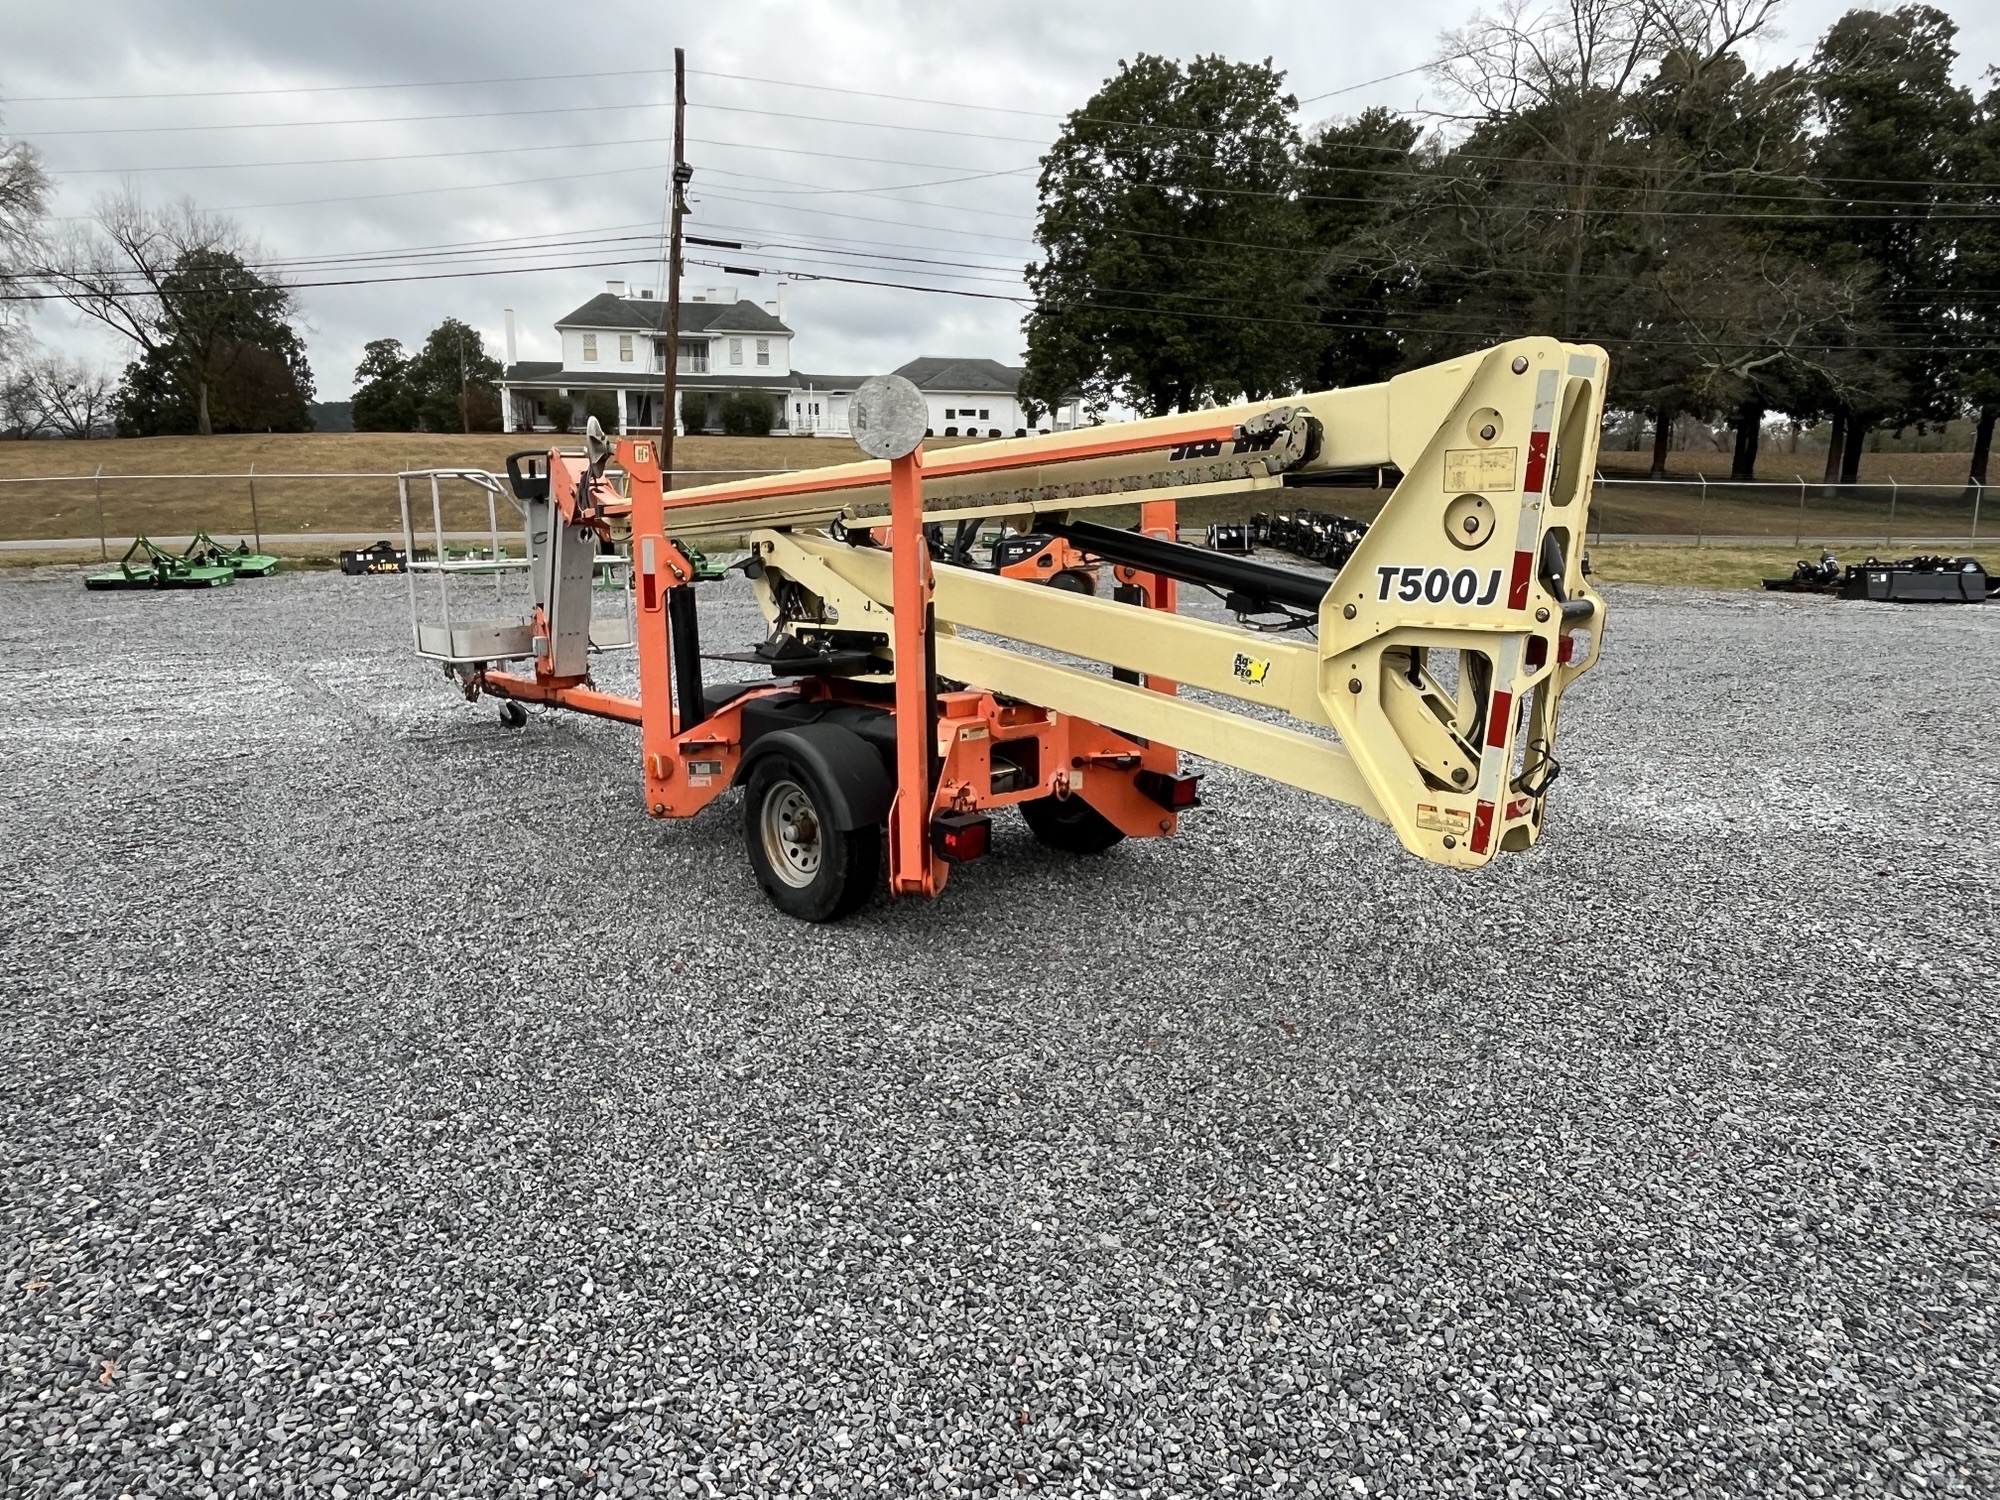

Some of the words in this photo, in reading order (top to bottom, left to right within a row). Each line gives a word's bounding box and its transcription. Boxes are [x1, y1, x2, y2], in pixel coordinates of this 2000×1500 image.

[1377, 566, 1502, 606] T500J
[1234, 653, 1249, 668] Ag
[1233, 664, 1252, 678] Pro
